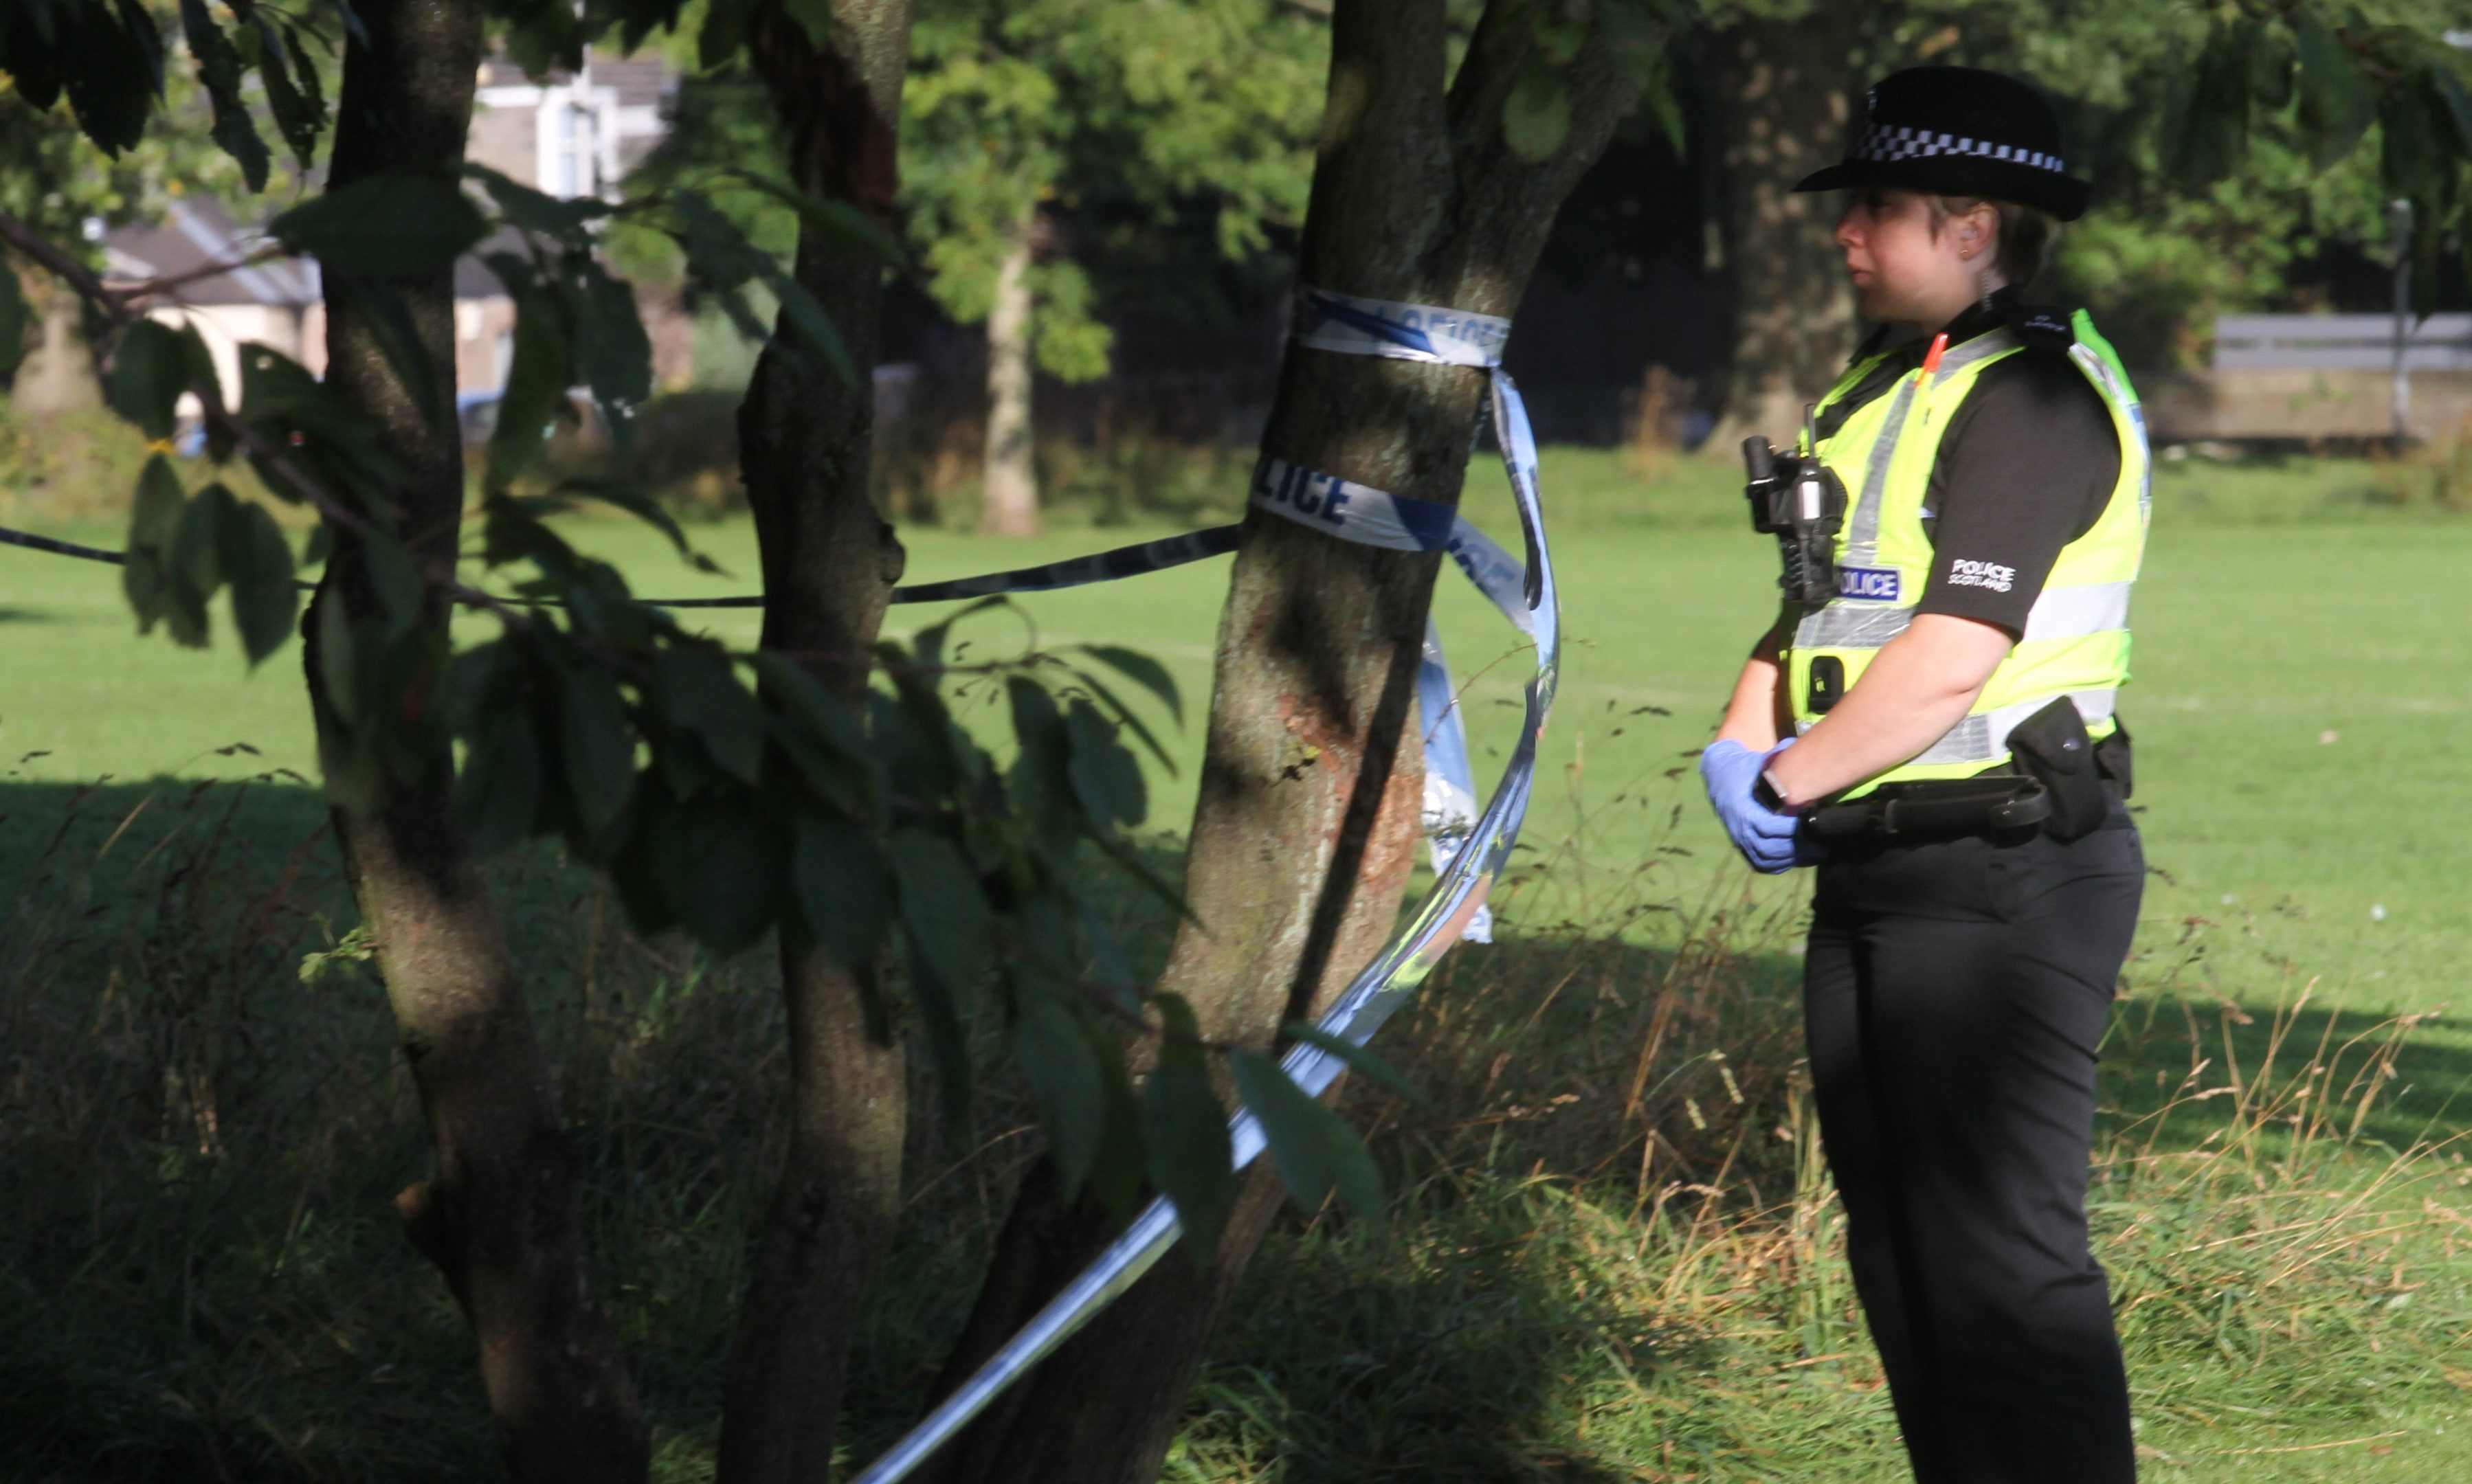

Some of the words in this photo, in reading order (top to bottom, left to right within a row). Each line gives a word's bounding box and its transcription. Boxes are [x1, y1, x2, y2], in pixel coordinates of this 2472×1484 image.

[1255, 459, 1351, 526] LICE
[1952, 559, 2016, 582] POLICE
[1840, 571, 1897, 596] OLICE
[1948, 574, 2012, 593] SCOTLAND
